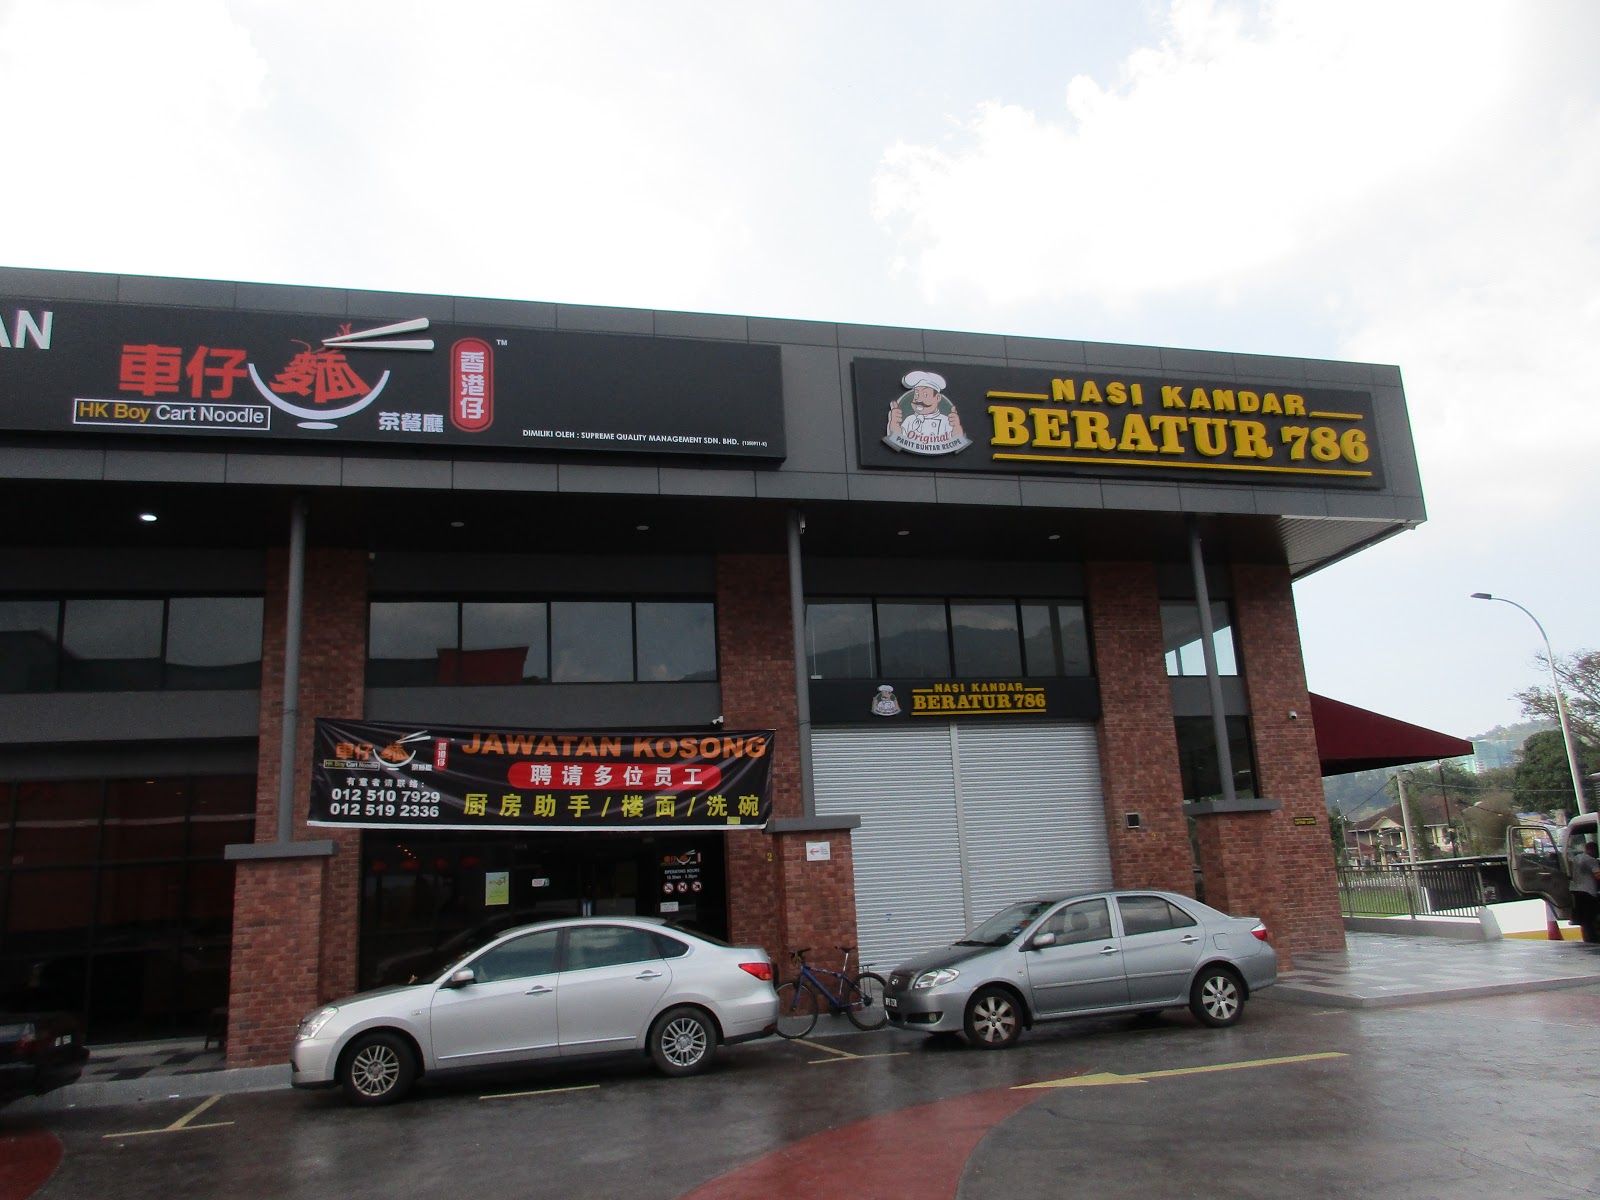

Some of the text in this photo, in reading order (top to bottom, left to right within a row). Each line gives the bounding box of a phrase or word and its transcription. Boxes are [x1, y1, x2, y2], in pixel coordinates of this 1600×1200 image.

[496, 338, 508, 346] TM
[460, 351, 485, 420] 香港仔
[1052, 378, 1306, 416] NASI KANDAR
[79, 403, 265, 424] HK Boy Cart Noodle
[378, 411, 444, 433] 茶餐廳
[522, 429, 554, 438] DIMILIKI
[555, 431, 575, 439] OLEH
[581, 432, 615, 440] SUPREME
[616, 433, 647, 442] QUALITY
[648, 434, 702, 444] MANAGEMENT
[703, 437, 721, 445] SDN.
[722, 437, 740, 446] BHD.
[896, 435, 962, 451] PARIT BUNTAR RECIPE
[907, 430, 949, 444] Original
[988, 405, 1369, 464] BERATUR 786
[933, 682, 1024, 693] NASI KANDAR
[912, 693, 1047, 710] BERATUR 786
[461, 734, 767, 759] JAWATAN KOSONG
[530, 764, 703, 787] 聘请多位员工
[332, 788, 441, 804] 012 510 7929
[329, 802, 440, 818] 012 519 2336
